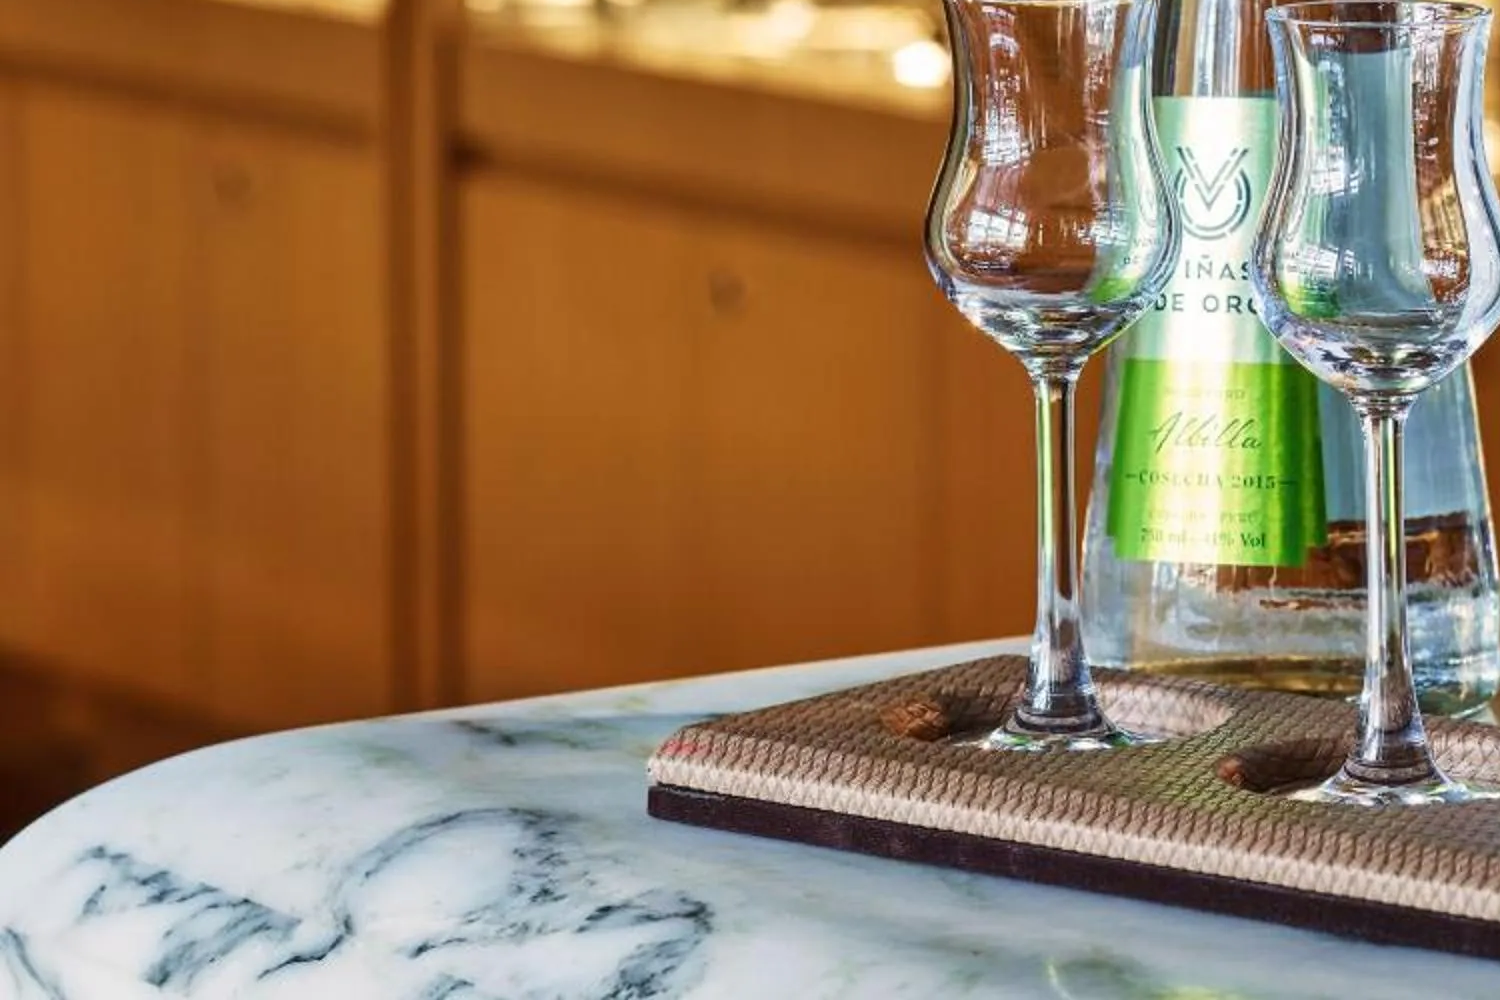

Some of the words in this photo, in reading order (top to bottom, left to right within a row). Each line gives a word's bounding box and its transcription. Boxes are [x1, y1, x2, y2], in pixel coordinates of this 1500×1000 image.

[1185, 254, 1251, 281] IÑAS
[1154, 293, 1185, 312] DE
[1231, 475, 1277, 490] 2015
[1240, 533, 1266, 549] Vol
